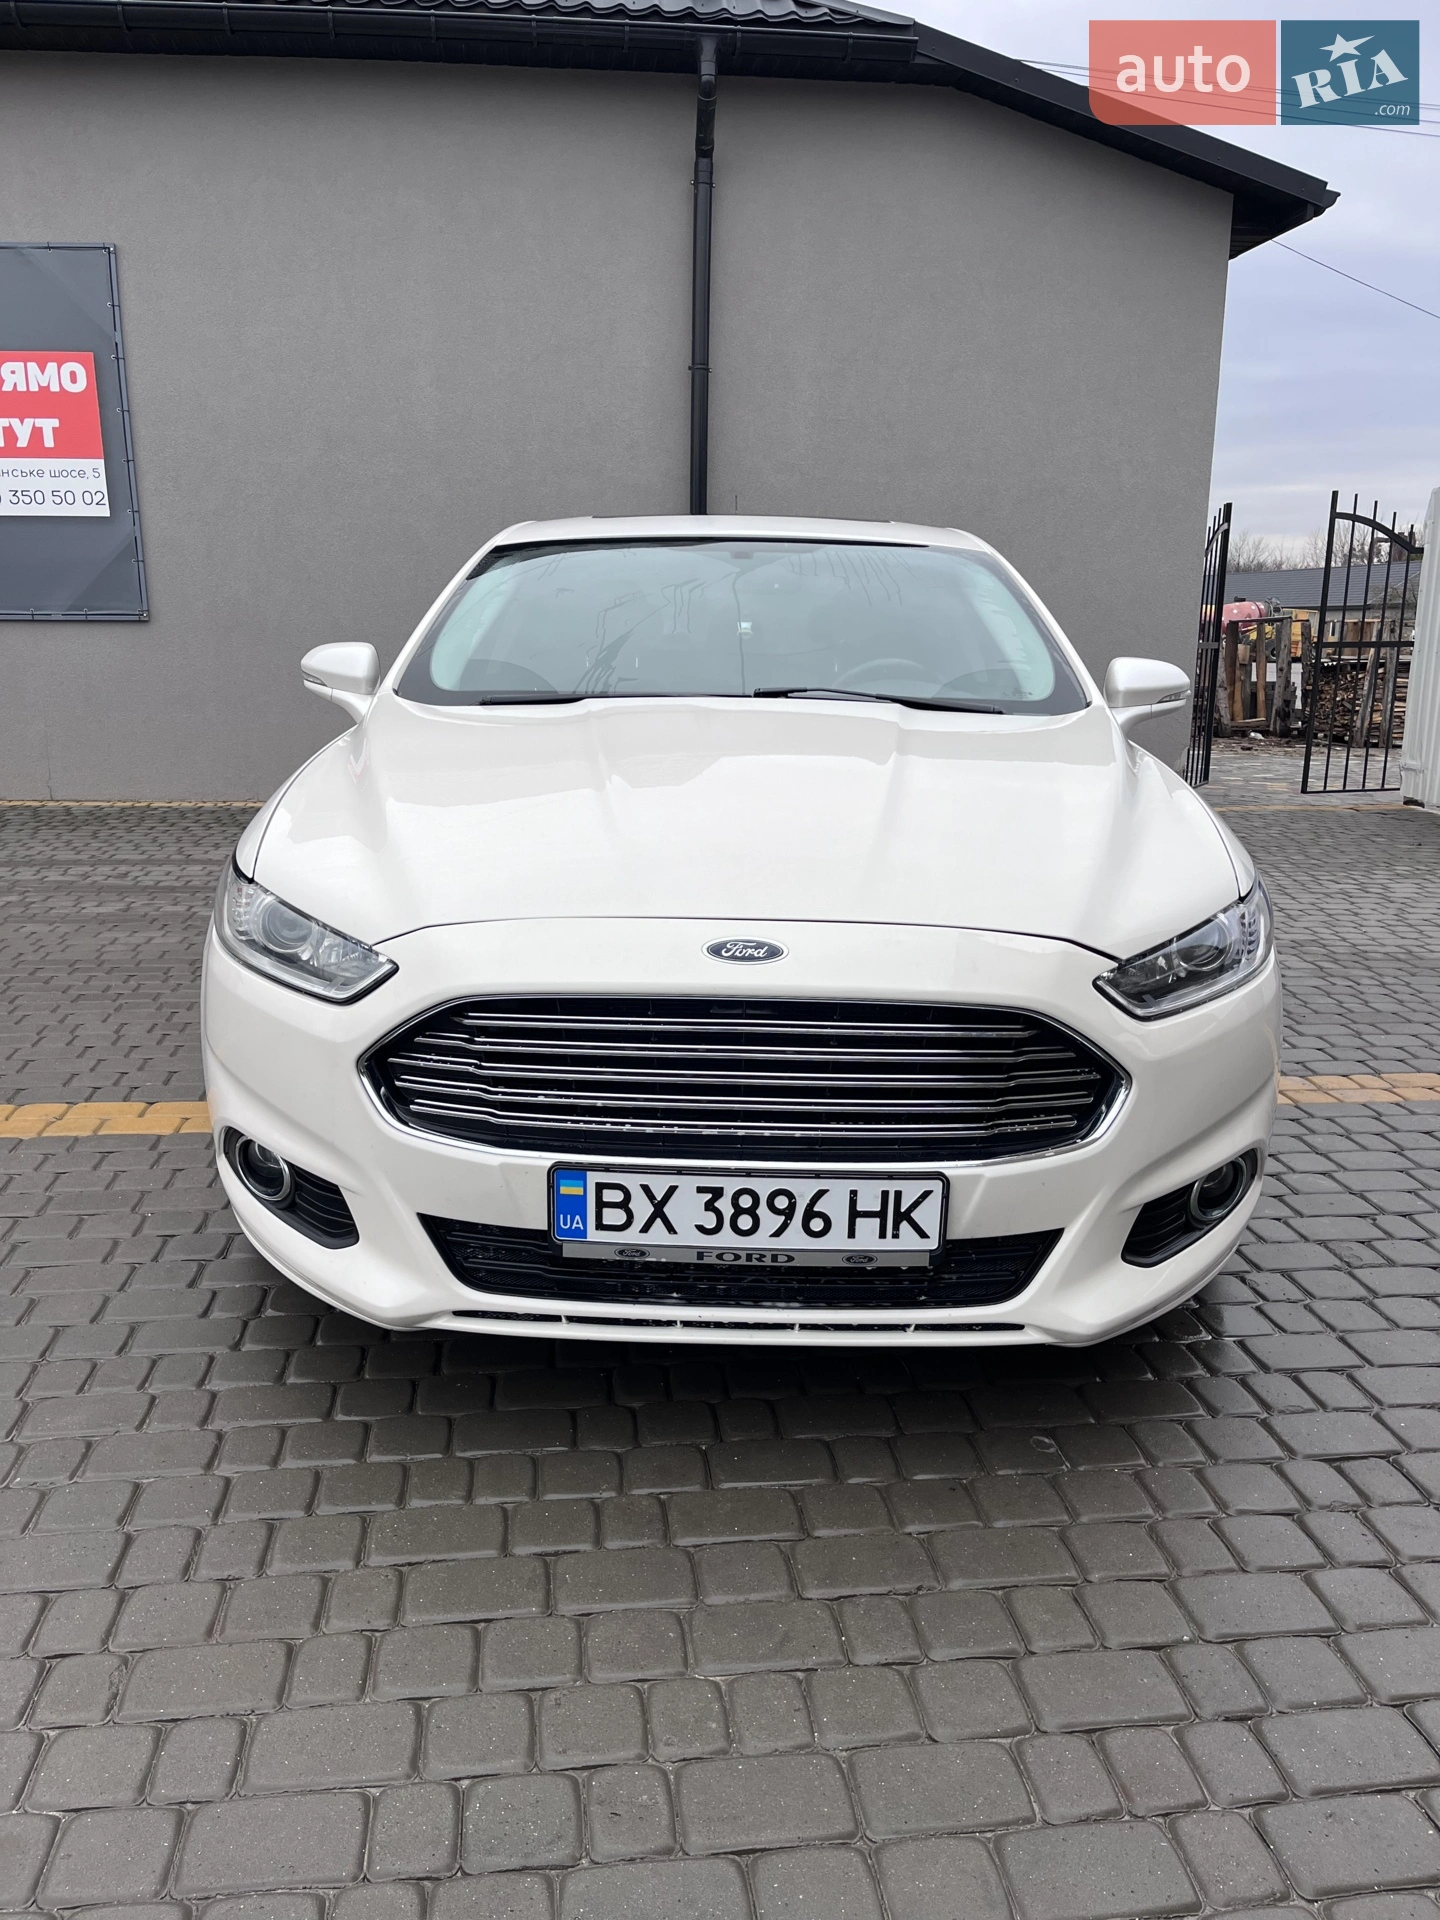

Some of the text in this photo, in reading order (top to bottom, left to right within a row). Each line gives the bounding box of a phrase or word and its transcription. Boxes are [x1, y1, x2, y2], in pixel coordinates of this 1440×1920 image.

[0, 467, 101, 480] нське шосе, 5
[8, 489, 46, 506] 350
[51, 490, 76, 506] 50
[81, 490, 107, 506] 02
[721, 941, 768, 957] Ford
[594, 1181, 934, 1240] BX 3896 HK
[560, 1214, 584, 1231] UA
[696, 1250, 796, 1265] FORD
